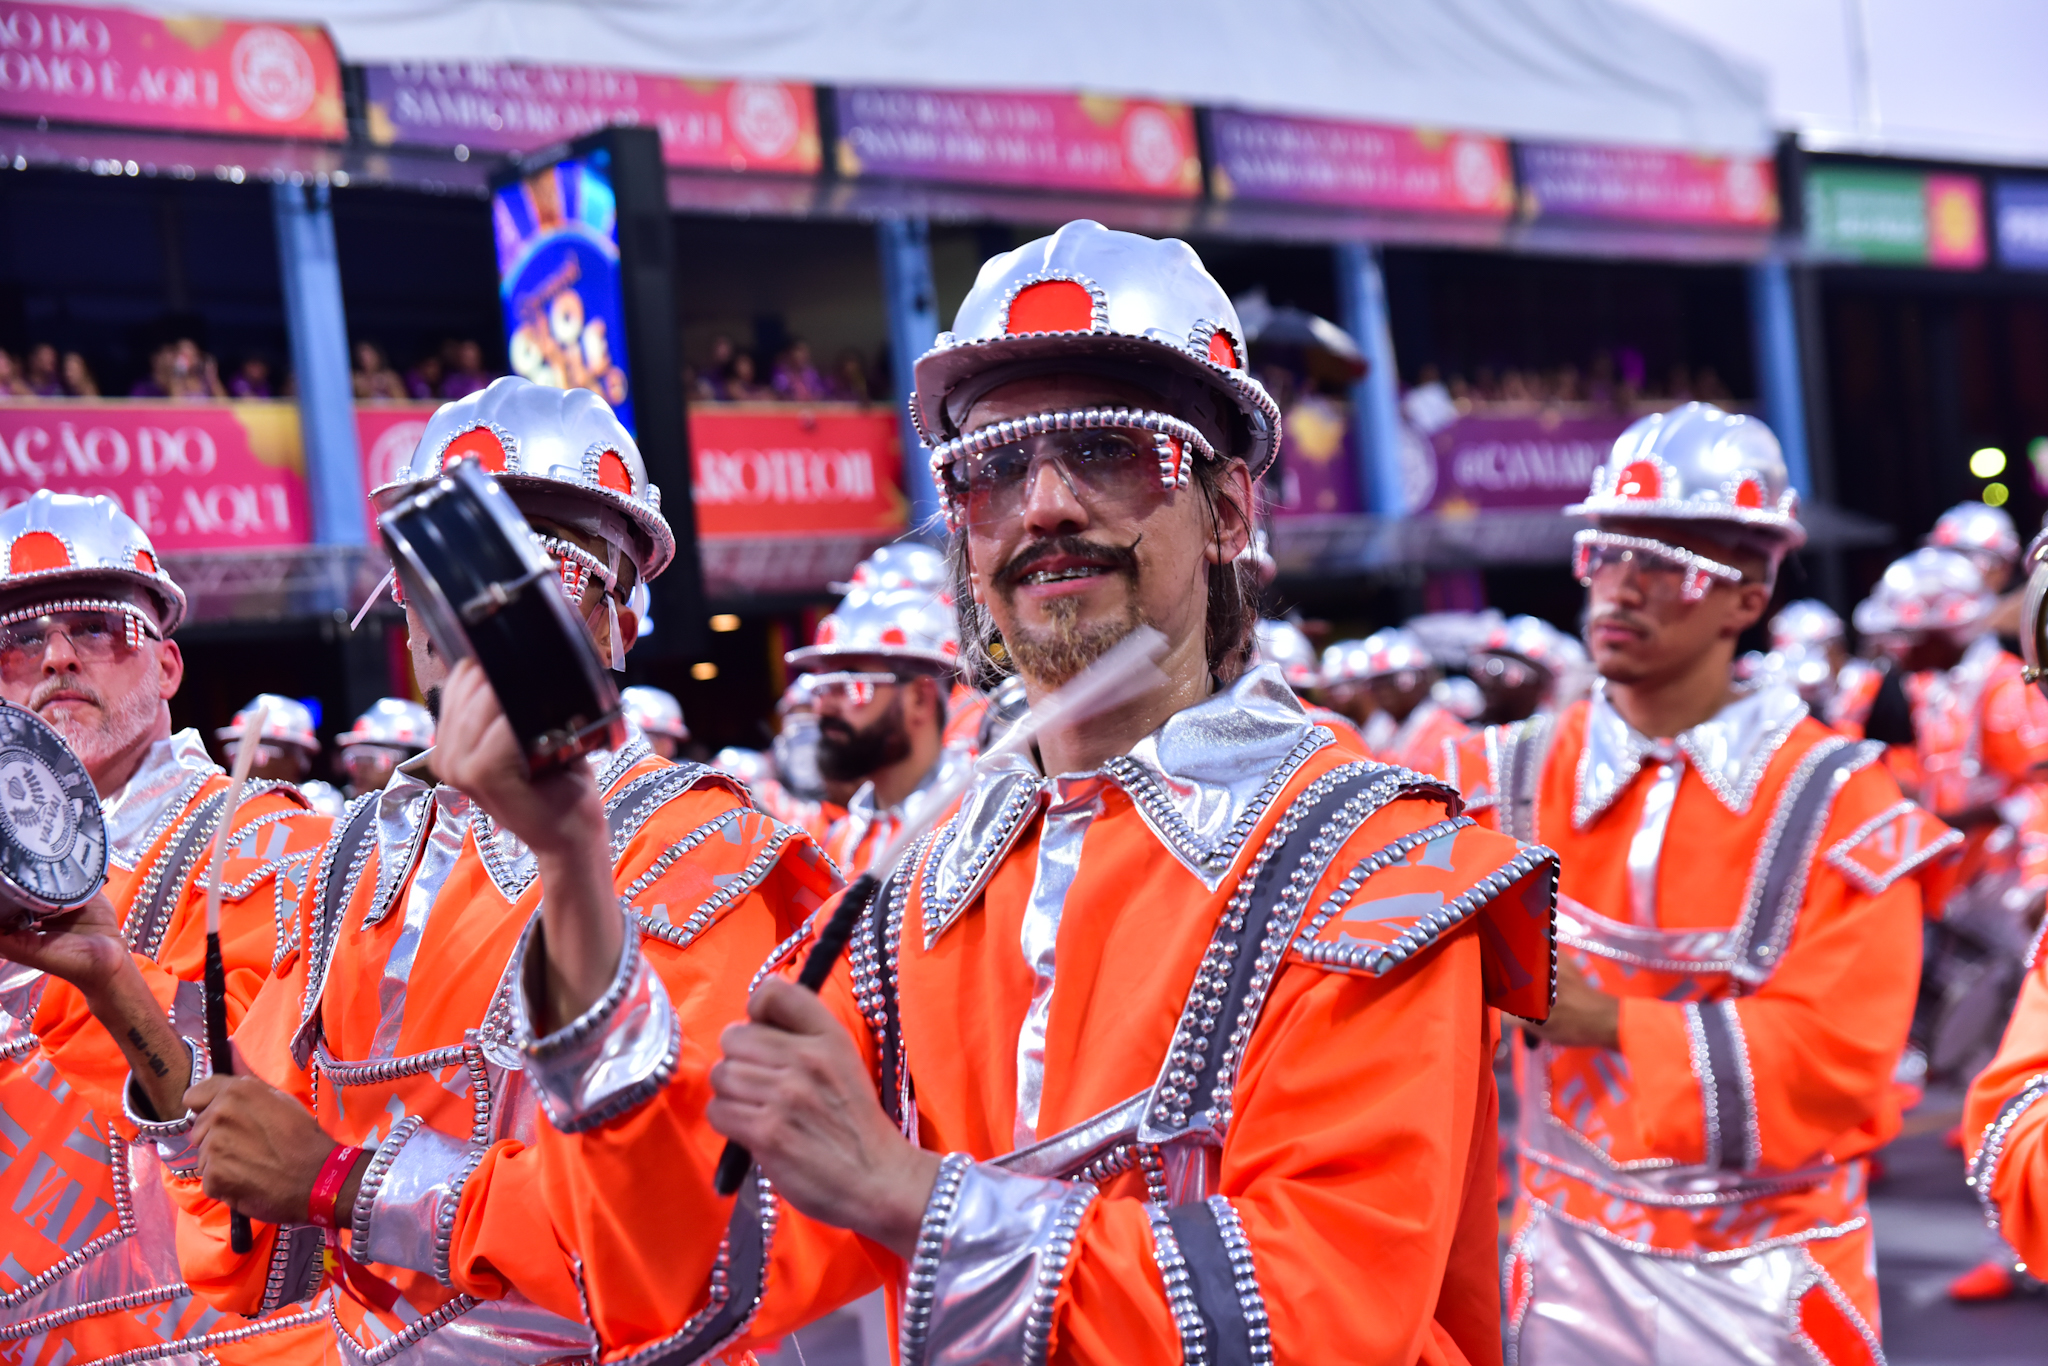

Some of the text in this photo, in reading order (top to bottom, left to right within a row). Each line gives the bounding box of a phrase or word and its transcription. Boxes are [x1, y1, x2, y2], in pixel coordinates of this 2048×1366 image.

[138, 425, 217, 477] DO
[174, 484, 291, 537] AQUI
[39, 793, 63, 845] VAI-VAI
[127, 1027, 169, 1079] VAI-VAI
